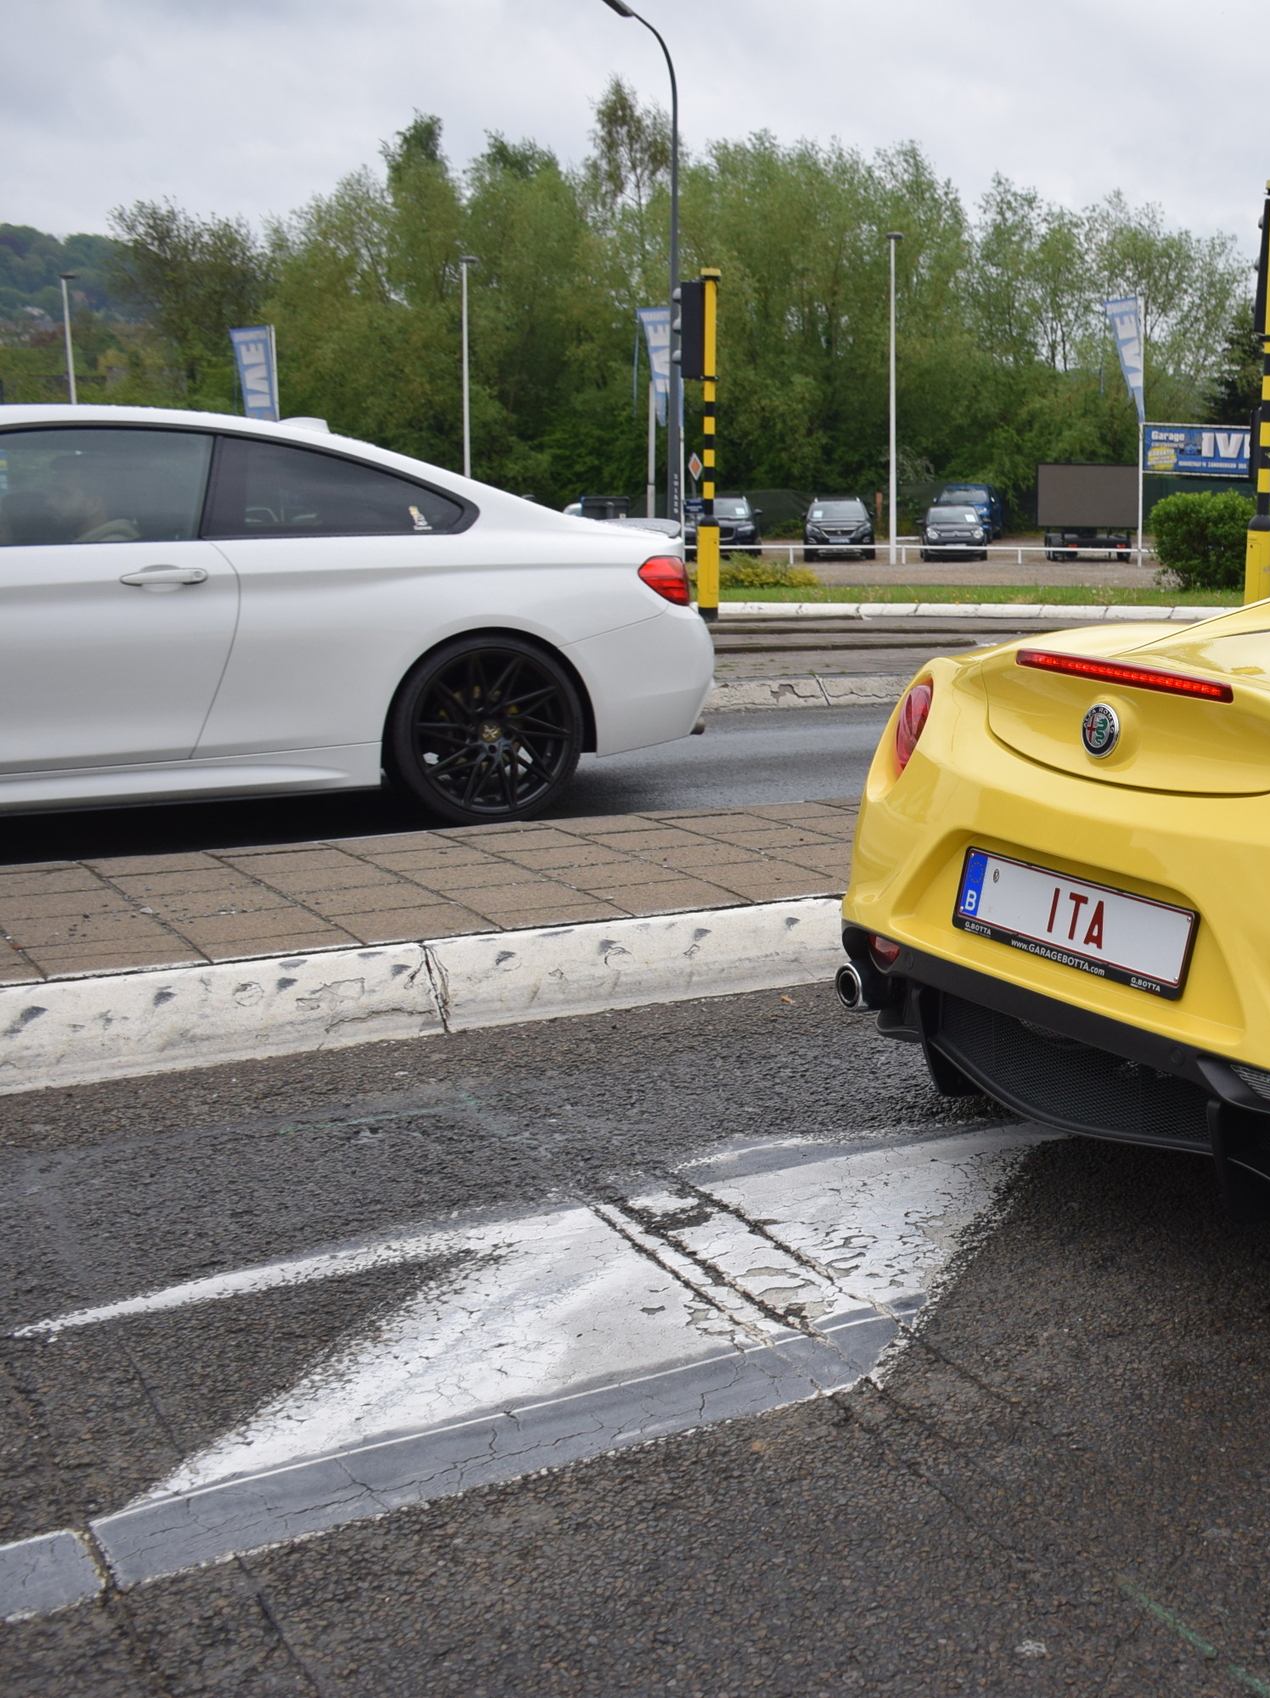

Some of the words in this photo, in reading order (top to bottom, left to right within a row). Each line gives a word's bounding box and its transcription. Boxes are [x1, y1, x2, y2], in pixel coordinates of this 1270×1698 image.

[1151, 430, 1185, 442] Garage
[1084, 708, 1097, 728] ALFA
[1098, 707, 1115, 733] ROMEO
[964, 889, 977, 911] B
[1046, 887, 1106, 950] ITA
[965, 921, 992, 936] G.BOTTA
[1011, 938, 1105, 976] www.GARAGEBOTTA.com
[1131, 976, 1161, 992] G.BOTTA
